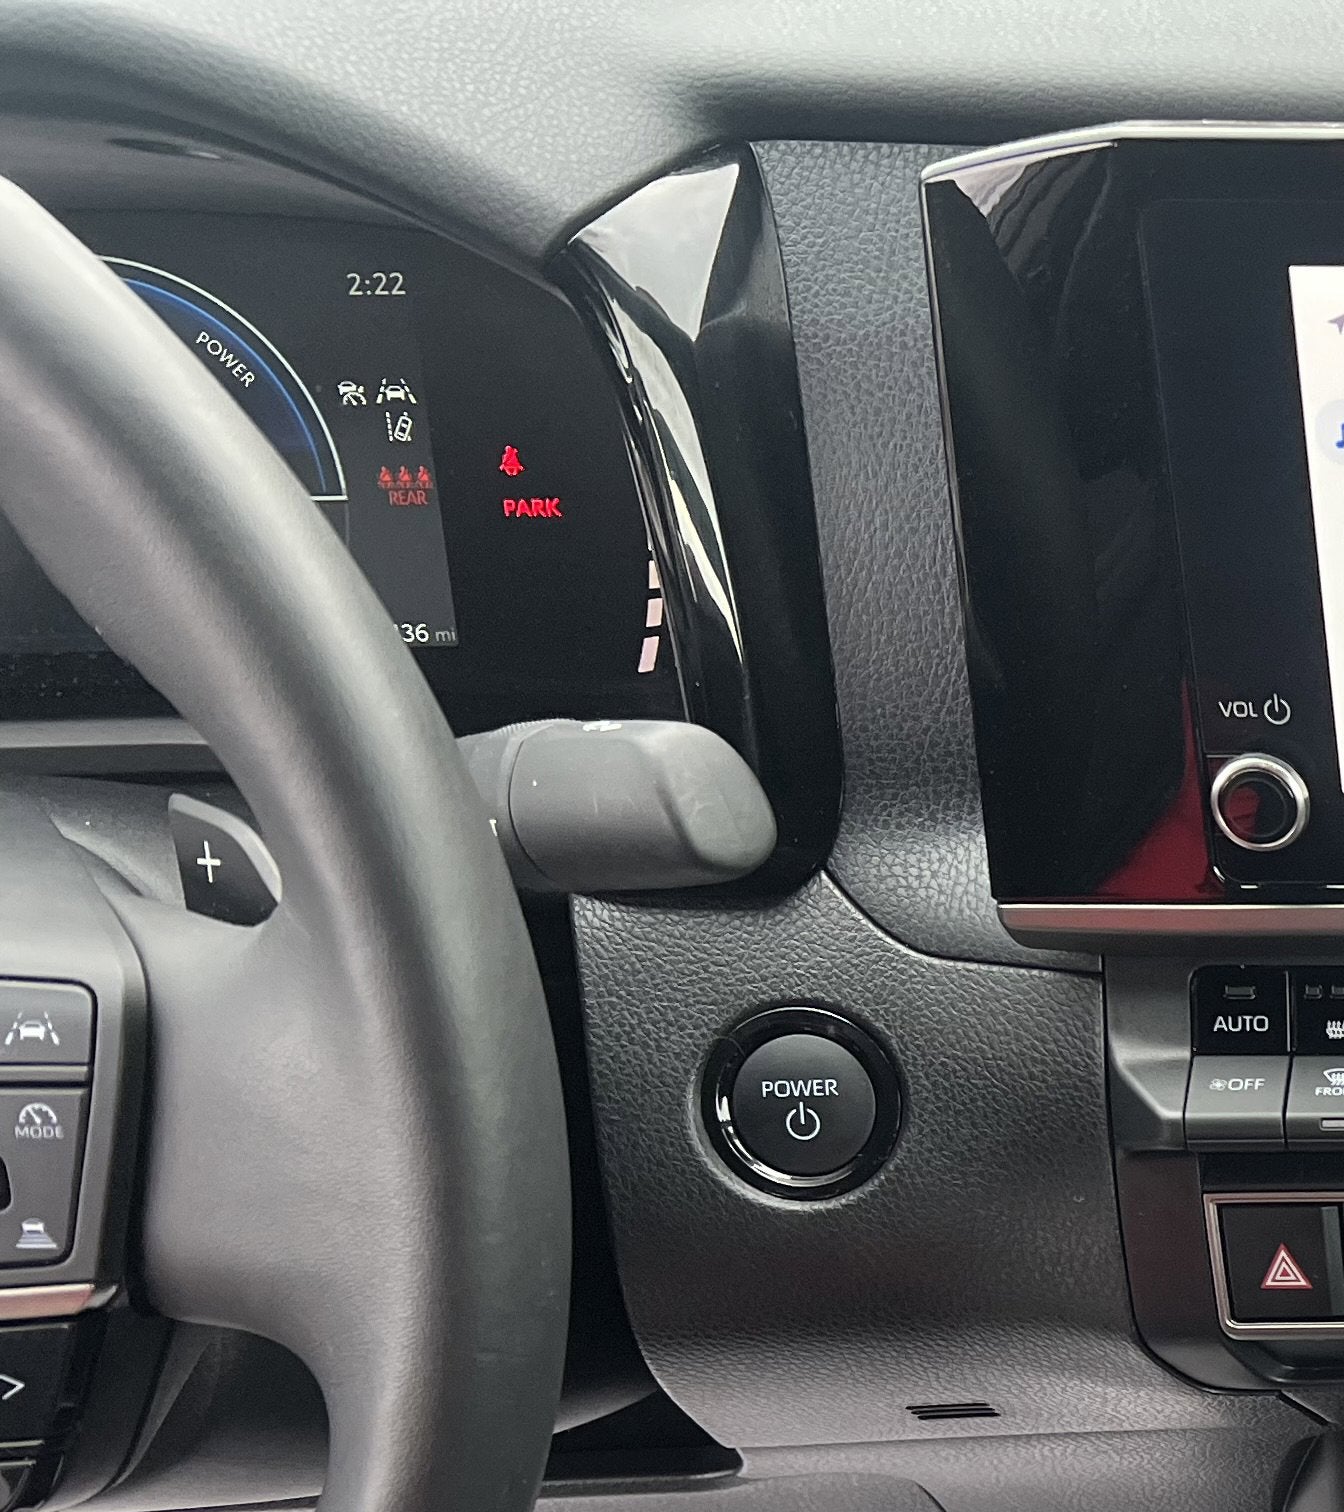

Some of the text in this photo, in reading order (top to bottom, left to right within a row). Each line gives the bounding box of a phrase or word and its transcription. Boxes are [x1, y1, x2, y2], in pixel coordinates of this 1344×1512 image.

[346, 272, 406, 296] 2:22
[195, 331, 255, 388] POWER
[388, 490, 428, 506] REAR
[503, 497, 563, 518] PARK
[1218, 701, 1259, 718] VOL
[1213, 1015, 1269, 1032] AUTO
[761, 1078, 839, 1098] POWER
[1227, 1078, 1265, 1091] OFF
[14, 1122, 66, 1141] MODE
